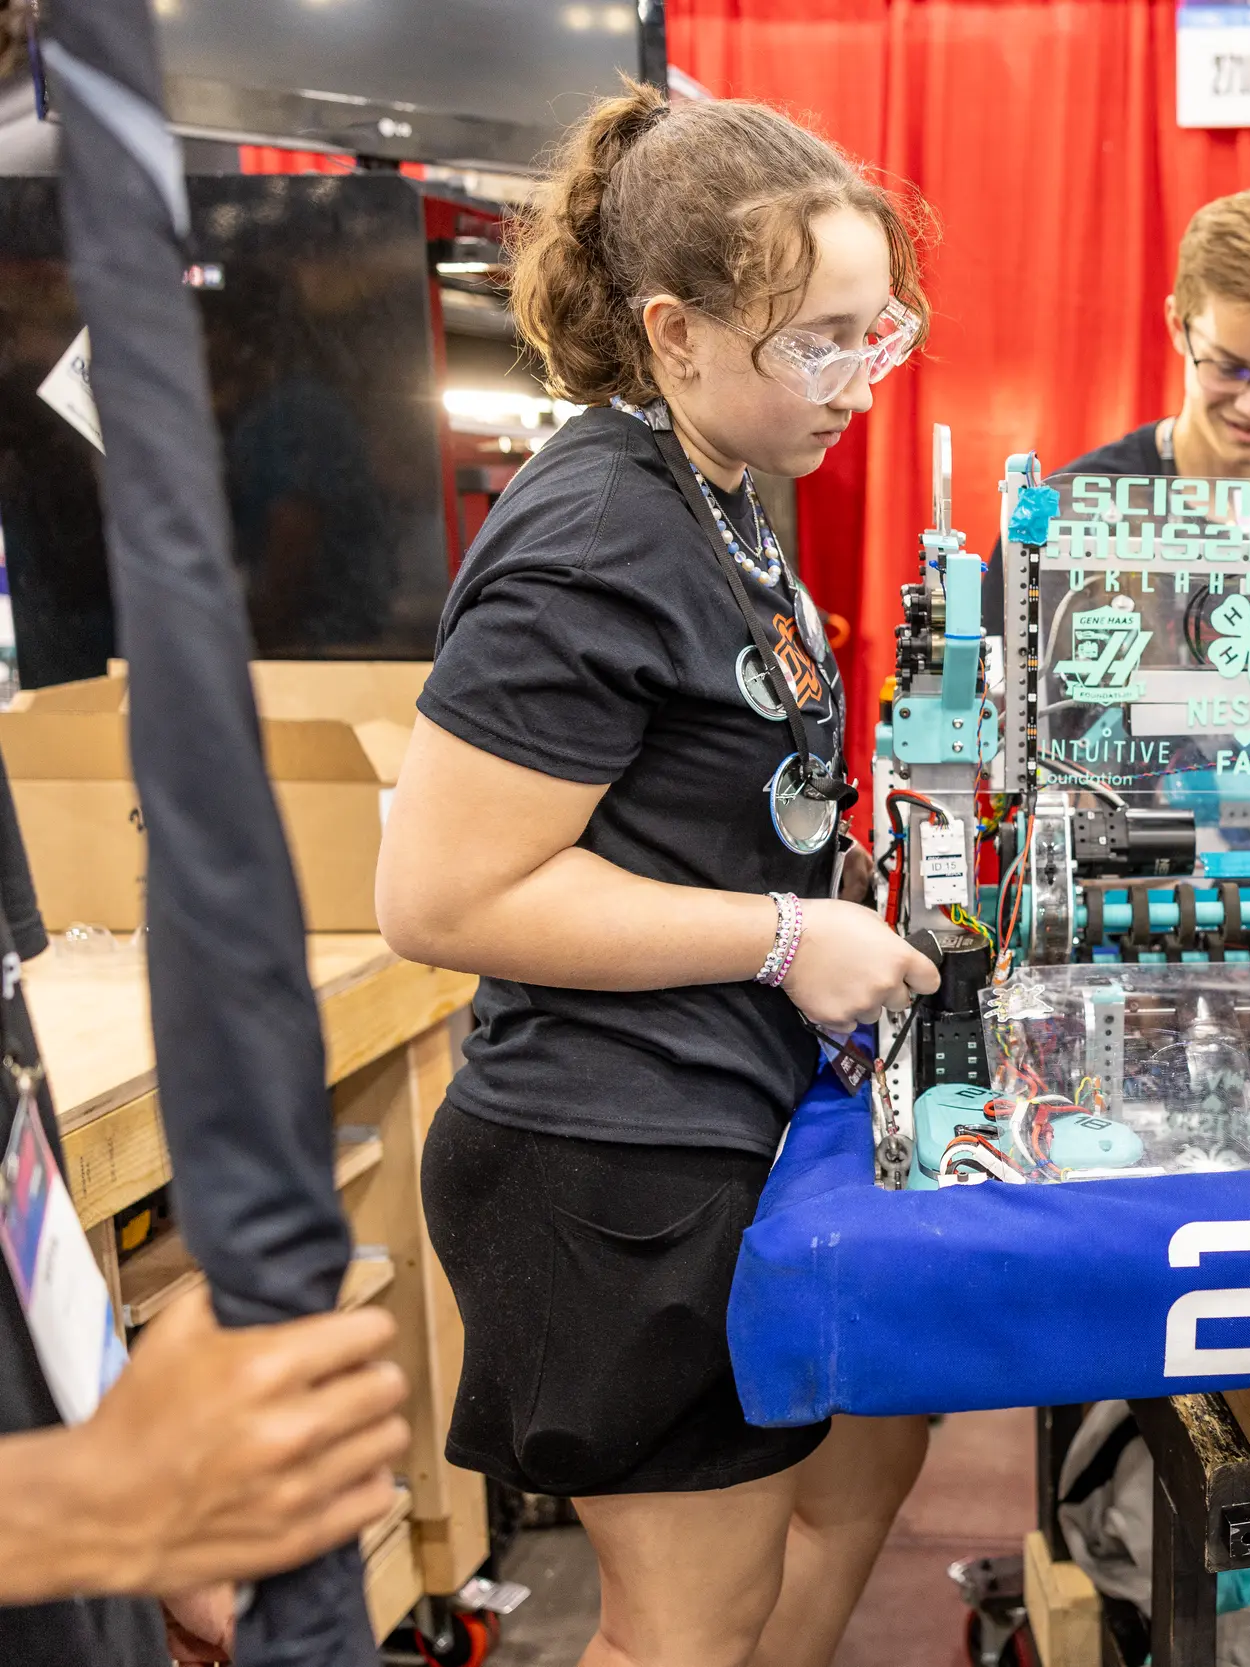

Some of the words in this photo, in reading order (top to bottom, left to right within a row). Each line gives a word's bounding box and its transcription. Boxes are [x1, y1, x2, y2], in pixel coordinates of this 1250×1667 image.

[1107, 617, 1134, 625] HAAS
[1040, 739, 1170, 764] INTUITIVE
[932, 863, 942, 871] ID
[945, 862, 957, 870] 15
